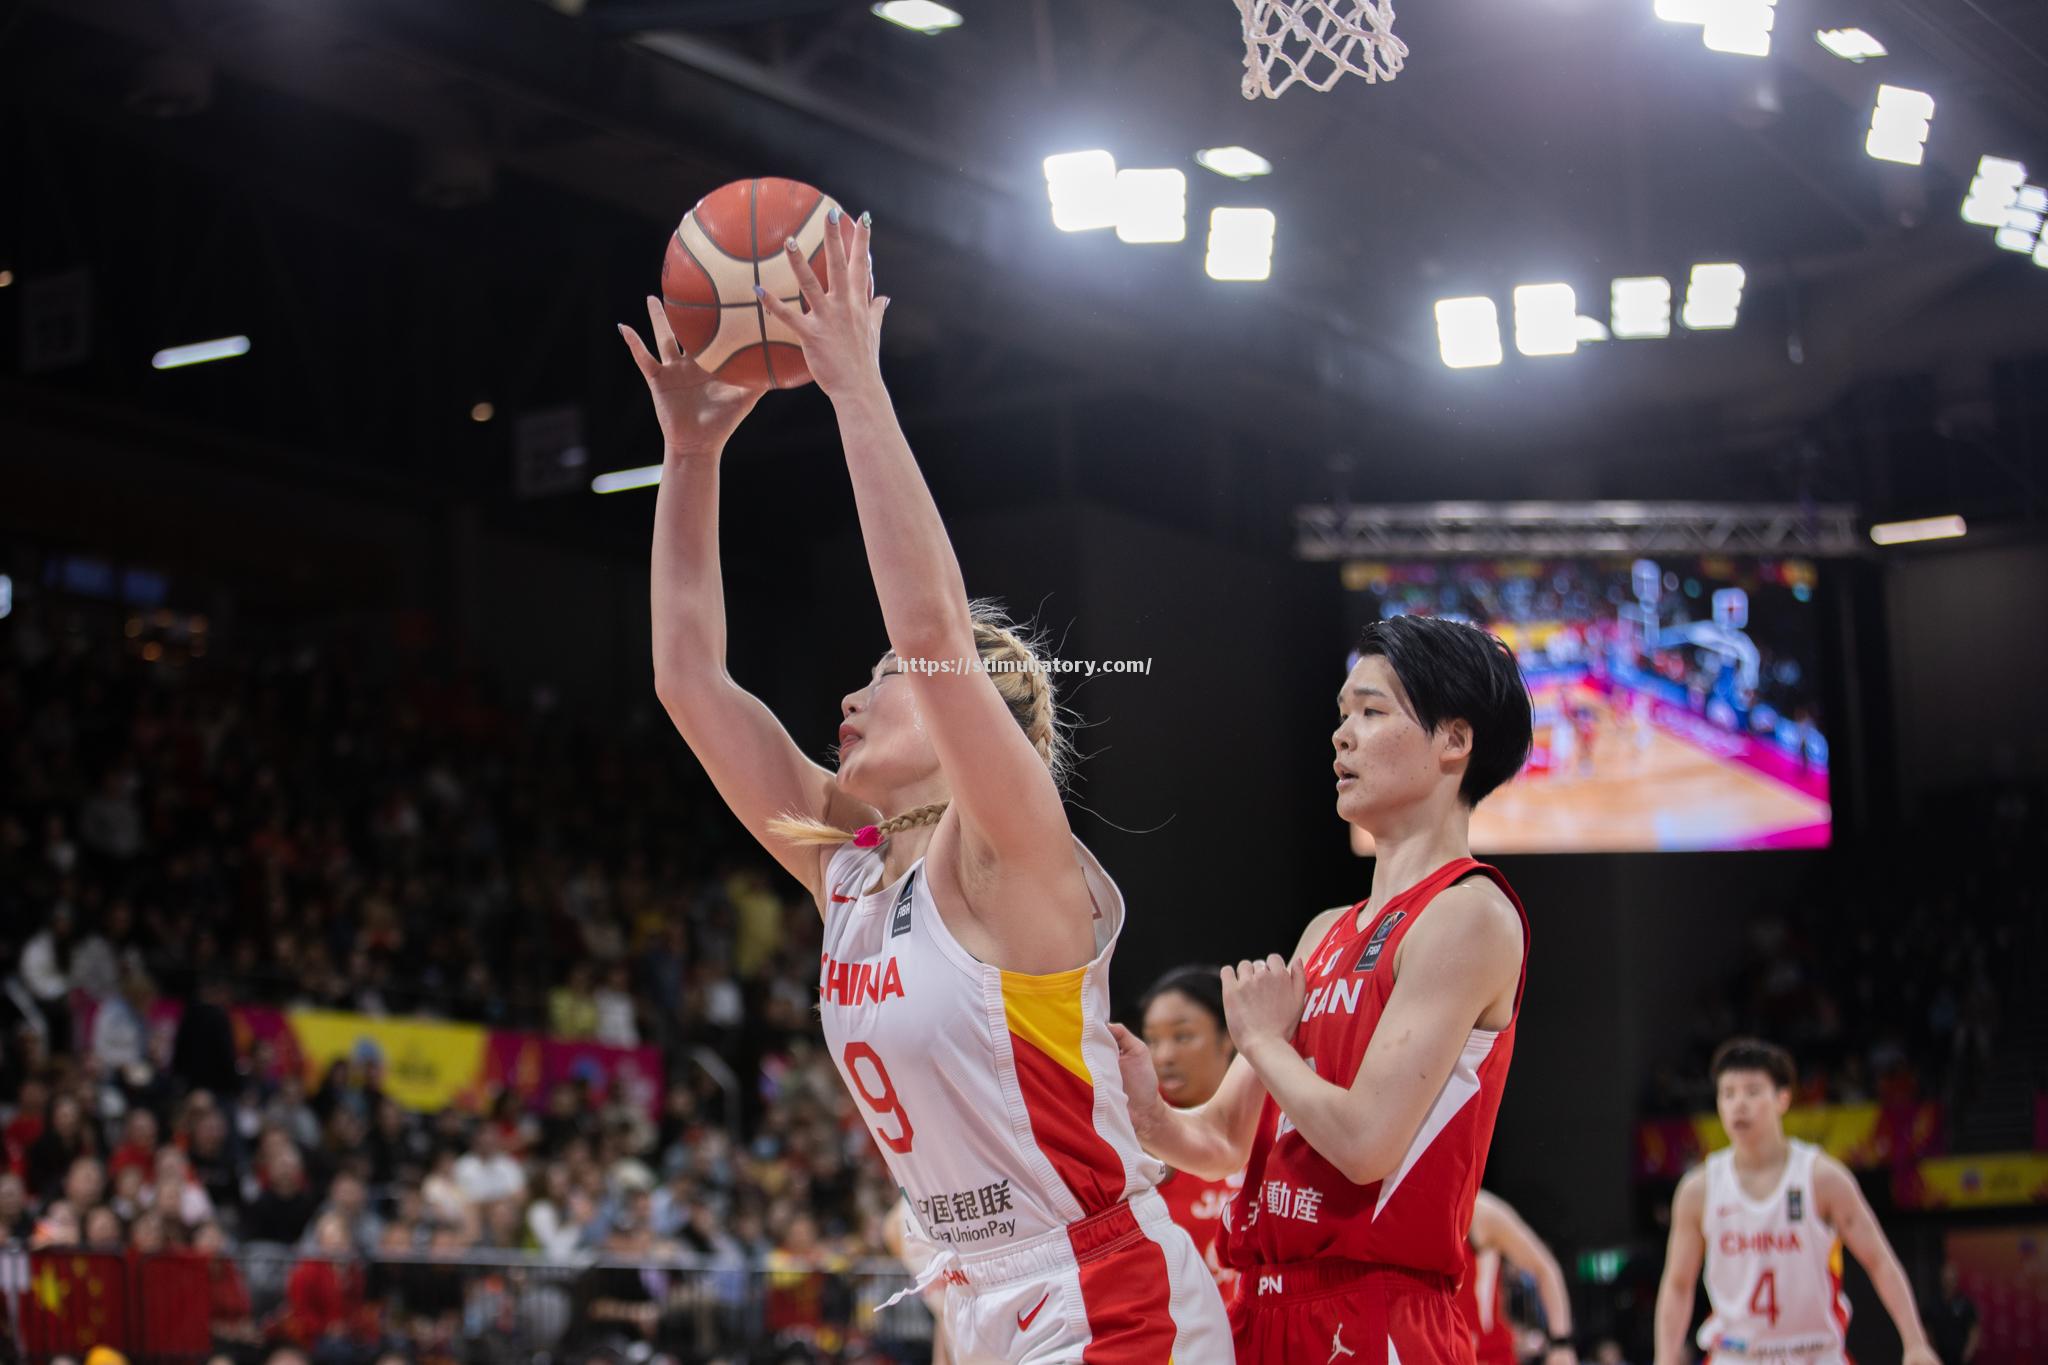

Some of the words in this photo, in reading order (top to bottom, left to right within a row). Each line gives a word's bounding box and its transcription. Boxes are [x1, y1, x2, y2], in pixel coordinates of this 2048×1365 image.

[843, 1041, 914, 1153] 9
[1720, 1231, 1801, 1255] CHINA
[1750, 1267, 1779, 1329] 4
